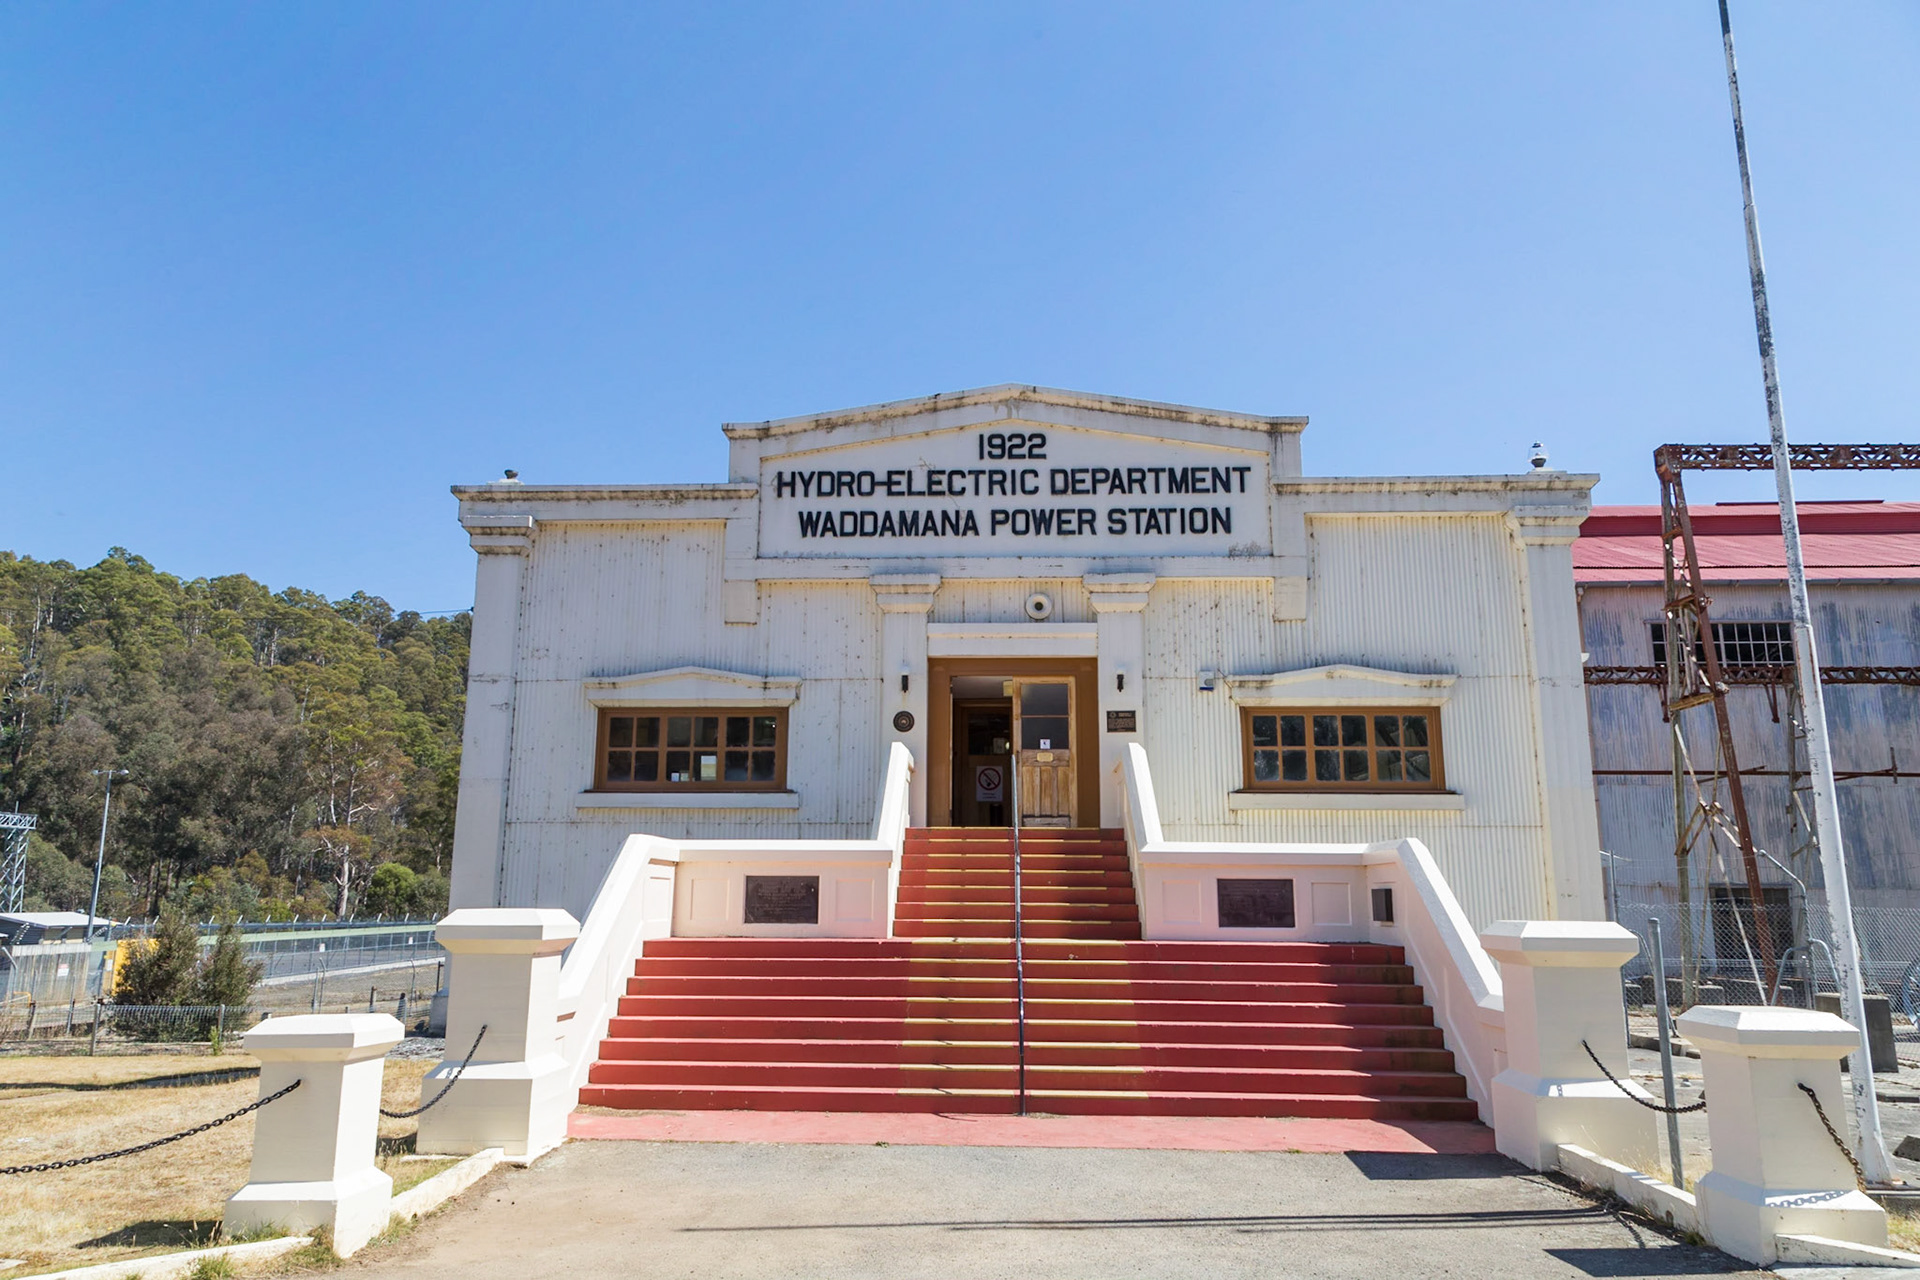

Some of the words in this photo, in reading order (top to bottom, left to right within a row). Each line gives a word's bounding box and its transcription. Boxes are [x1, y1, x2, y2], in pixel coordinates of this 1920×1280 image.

[978, 433, 1046, 461] 1922
[776, 469, 1040, 498] HYDRO-ELECTRIC
[1050, 467, 1252, 496] DEPARTMENT
[797, 509, 980, 538] WADDAMANA
[990, 508, 1097, 537] POWER
[1107, 507, 1232, 536] STATION
